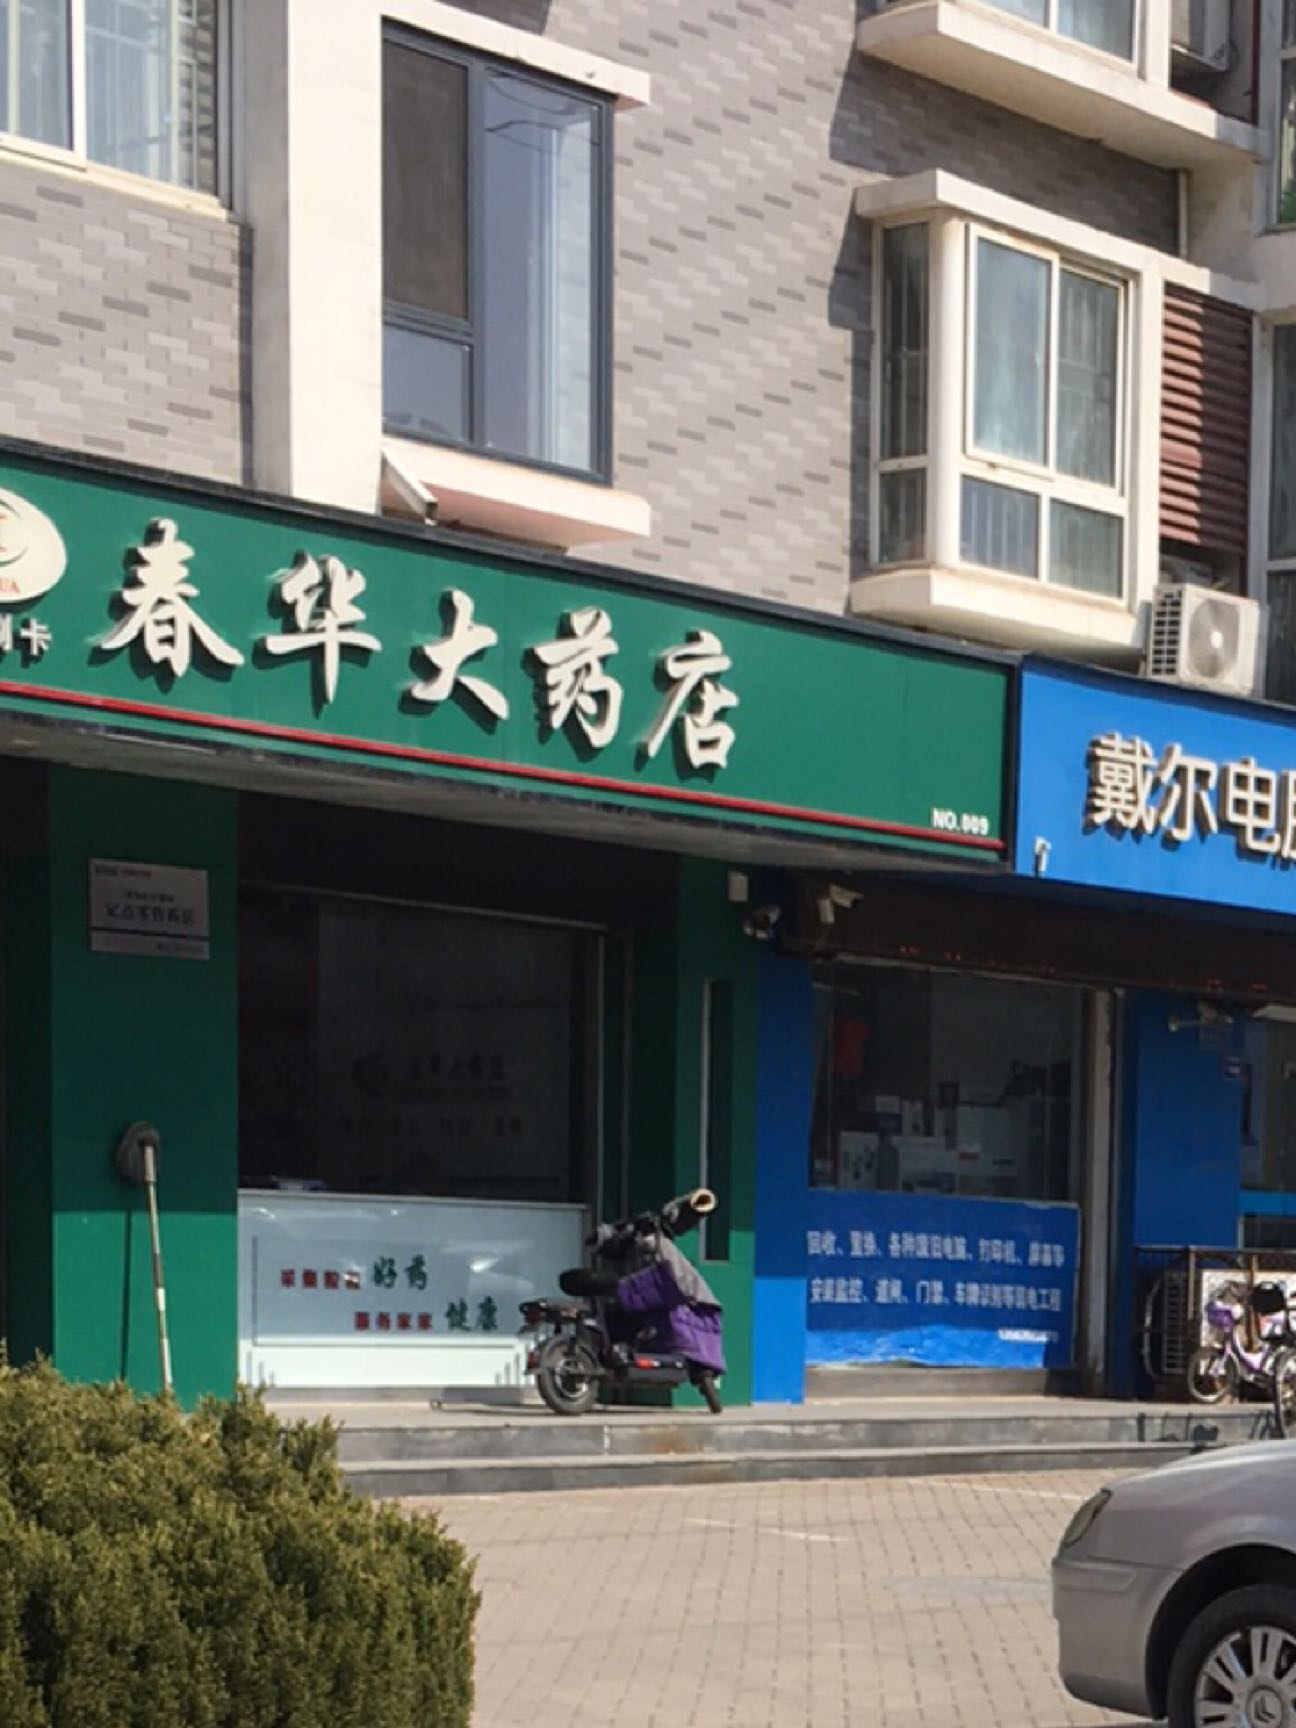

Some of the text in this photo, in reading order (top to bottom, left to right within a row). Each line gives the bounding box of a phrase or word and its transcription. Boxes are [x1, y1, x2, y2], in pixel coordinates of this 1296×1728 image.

[98, 517, 741, 770] 春华大药店
